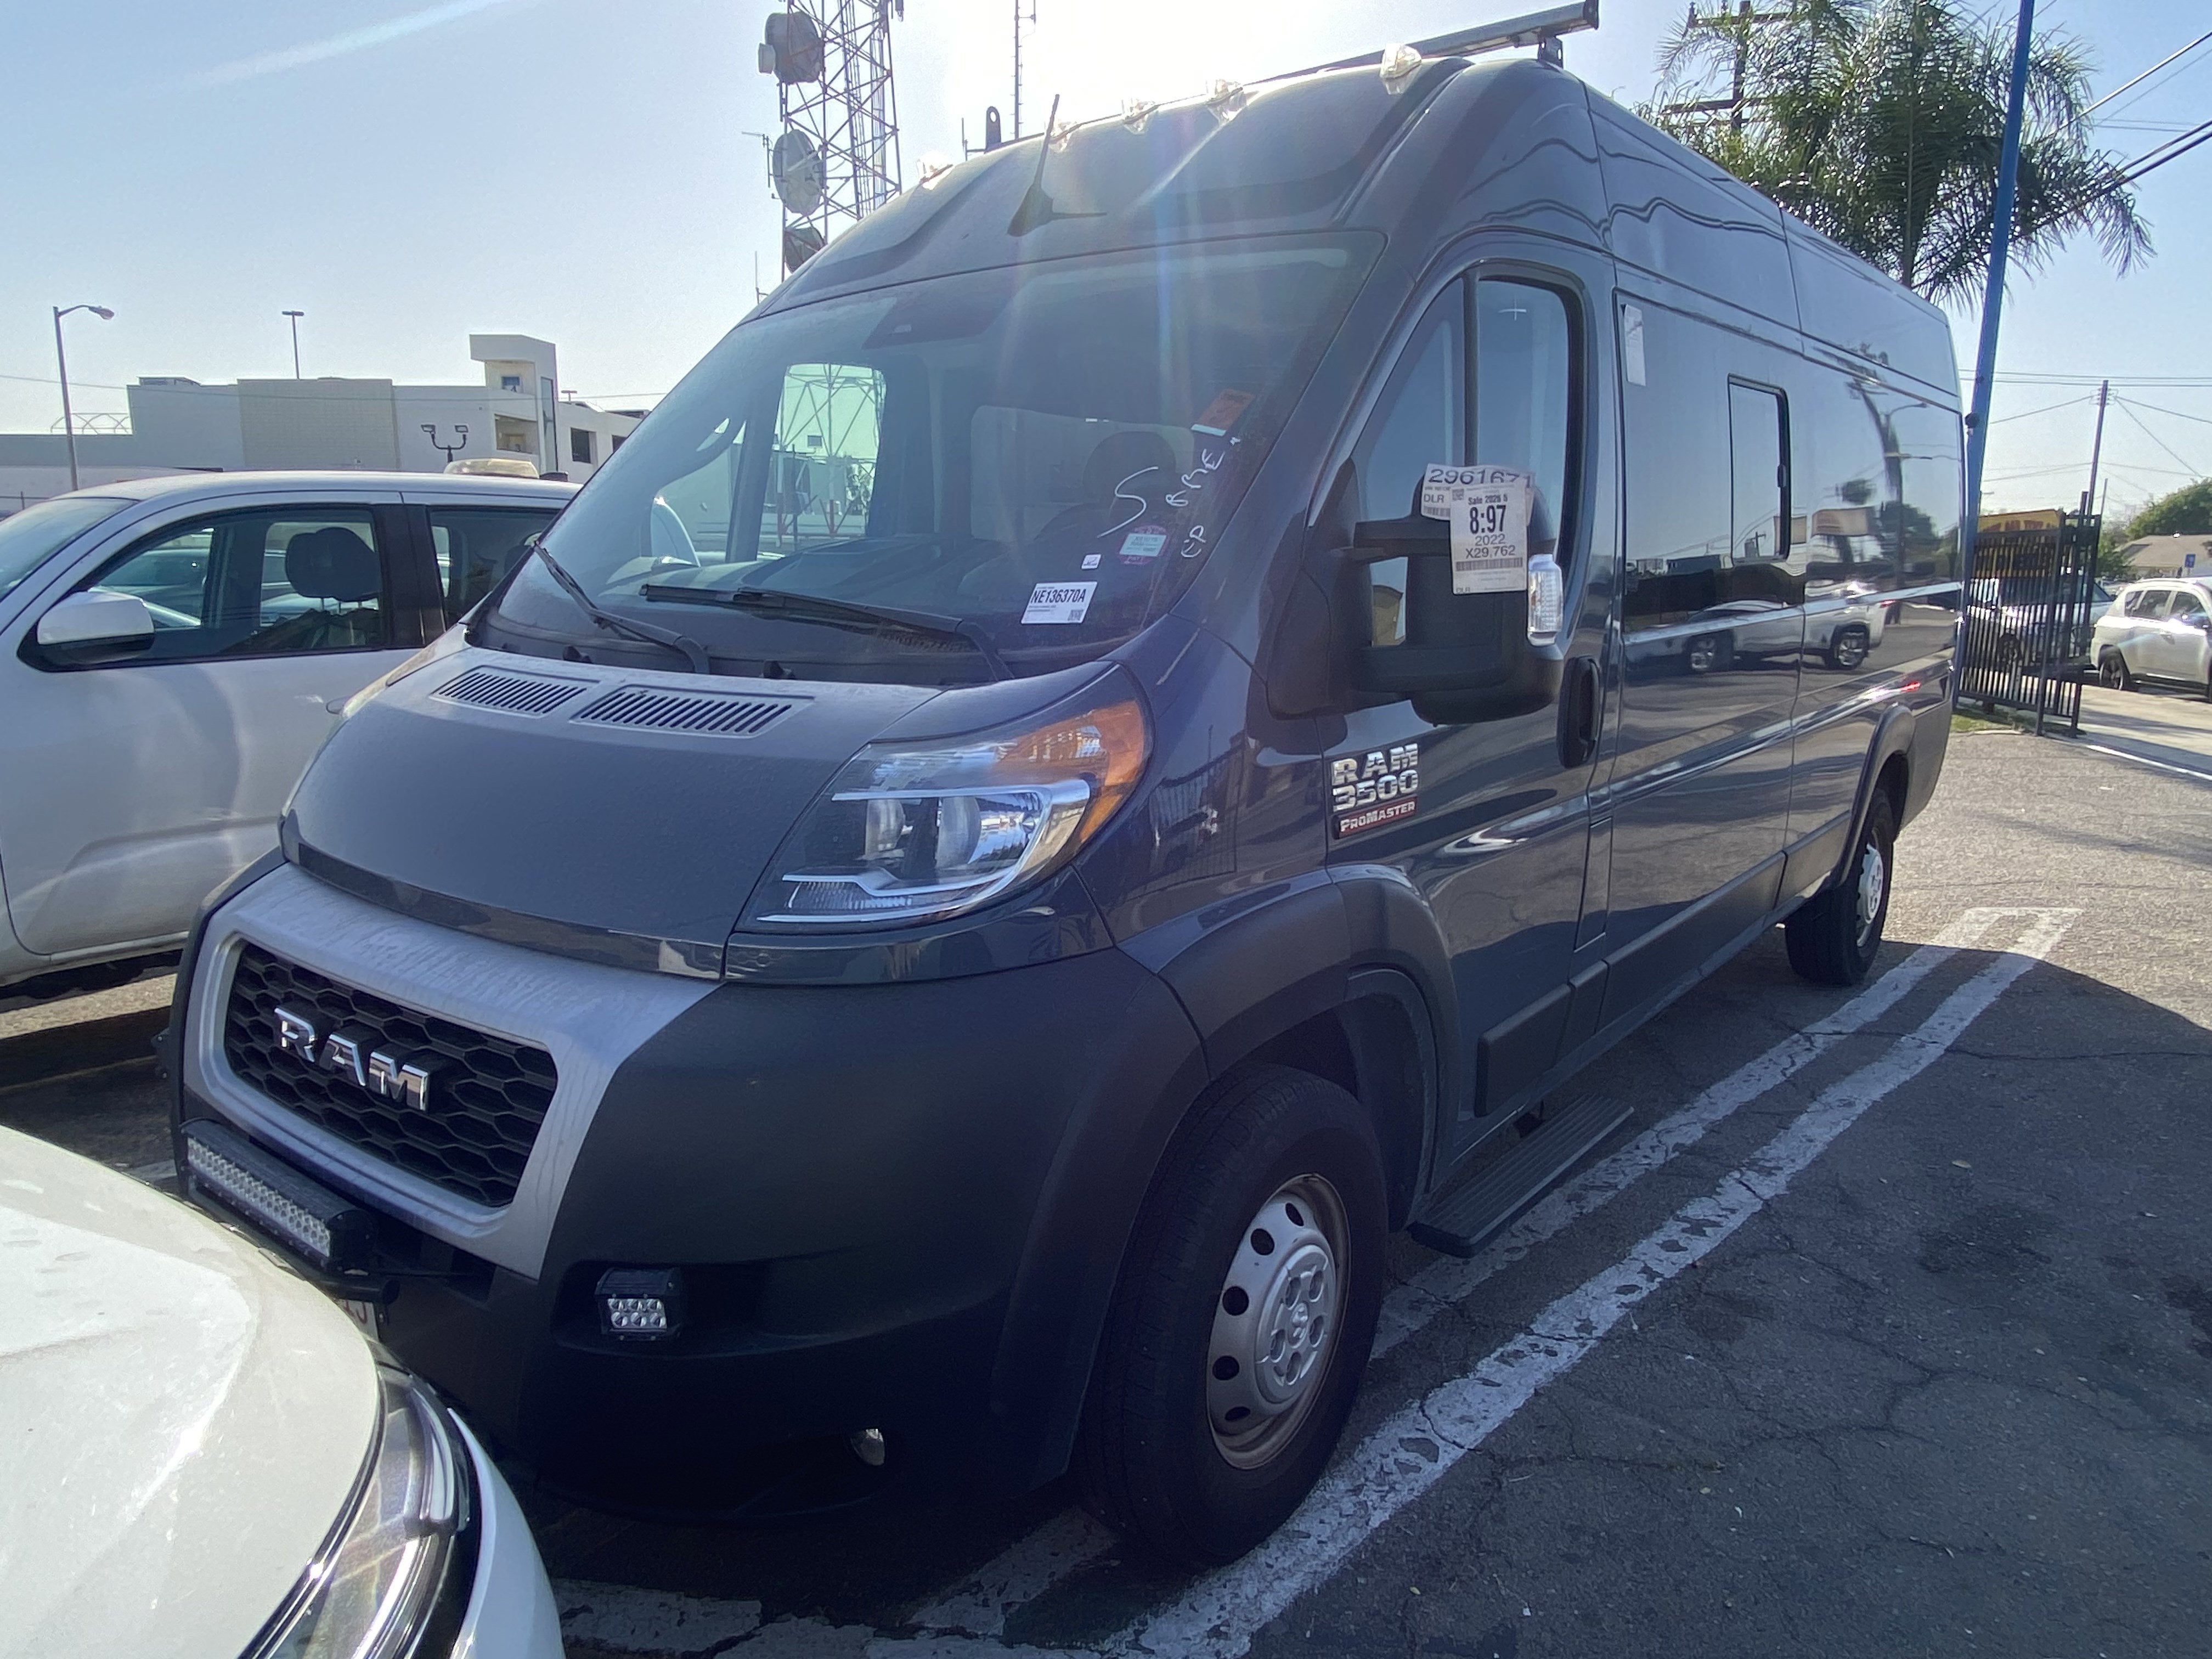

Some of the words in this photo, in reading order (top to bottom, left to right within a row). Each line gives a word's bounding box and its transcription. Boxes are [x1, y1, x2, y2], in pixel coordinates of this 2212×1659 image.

[1424, 494, 1444, 503] DLR
[1470, 504, 1506, 534] 8:97
[1475, 533, 1505, 546] 2022
[1031, 589, 1087, 603] NE136370A
[1331, 743, 1418, 786] RAM
[1332, 769, 1419, 812] 3500
[274, 1006, 429, 1111] RAM
